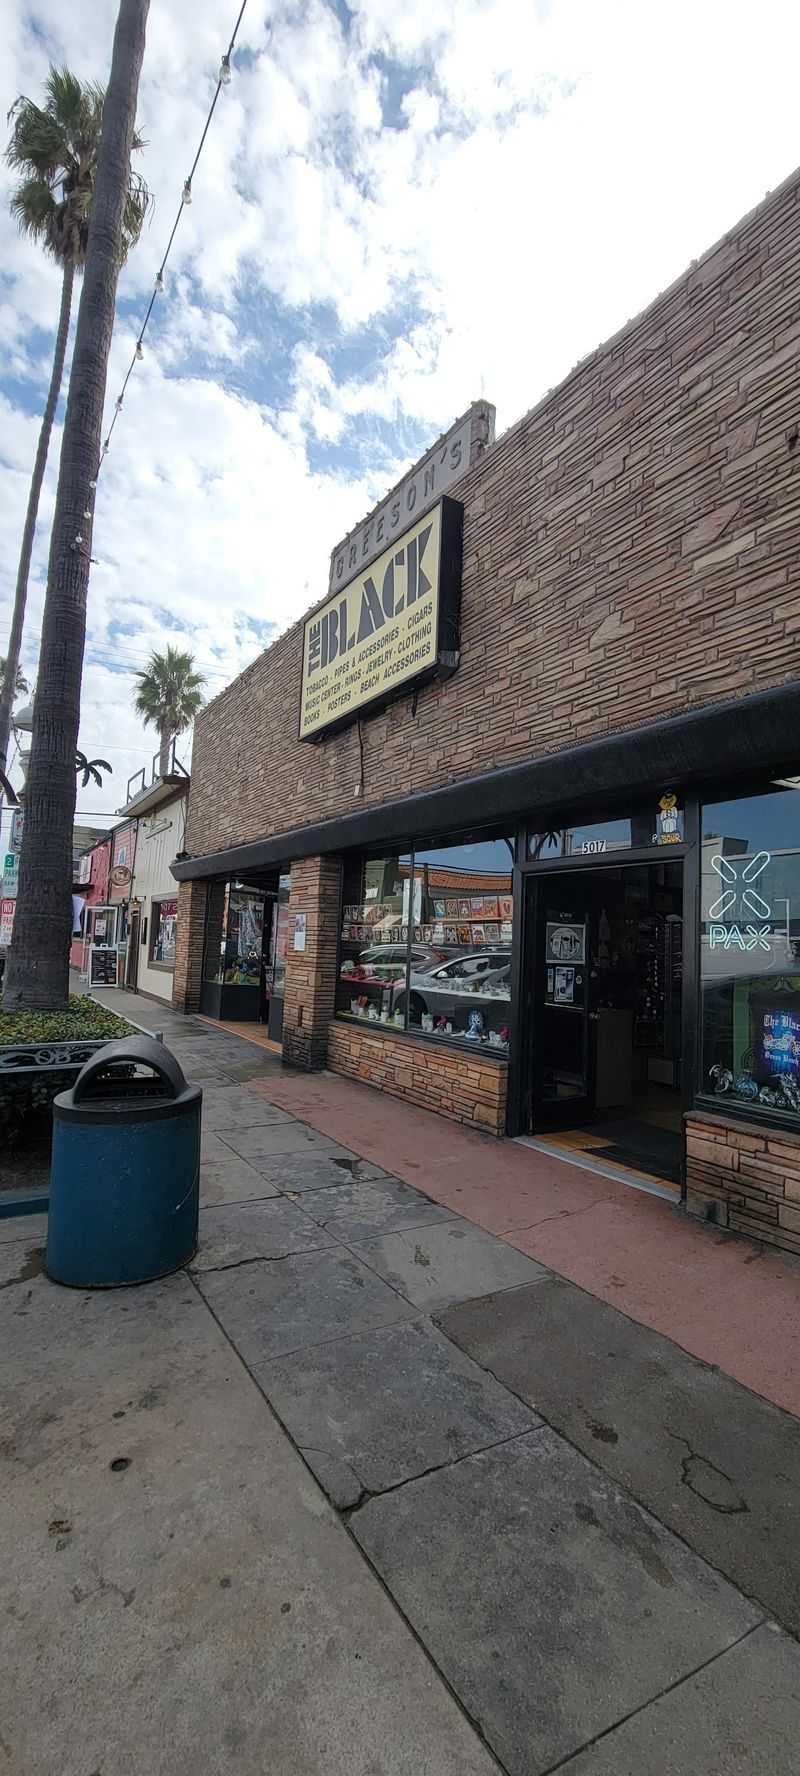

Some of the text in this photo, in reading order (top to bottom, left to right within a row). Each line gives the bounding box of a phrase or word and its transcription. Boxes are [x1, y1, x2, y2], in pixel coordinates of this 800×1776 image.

[308, 522, 434, 678] THE BLACK
[304, 641, 431, 726] BOOKS POSTERS BEACH ACCESSORIES
[305, 621, 432, 712] MUSIC CENTER RINGS JEWELRY CLOTHING
[306, 675, 329, 697] TOBACCO
[335, 660, 350, 679] PIPES
[358, 626, 400, 664] ACCESSORIES
[407, 601, 433, 630] CIGARS
[583, 840, 605, 853] 5017
[709, 924, 771, 951] PAX
[781, 1015, 800, 1031] Blac
